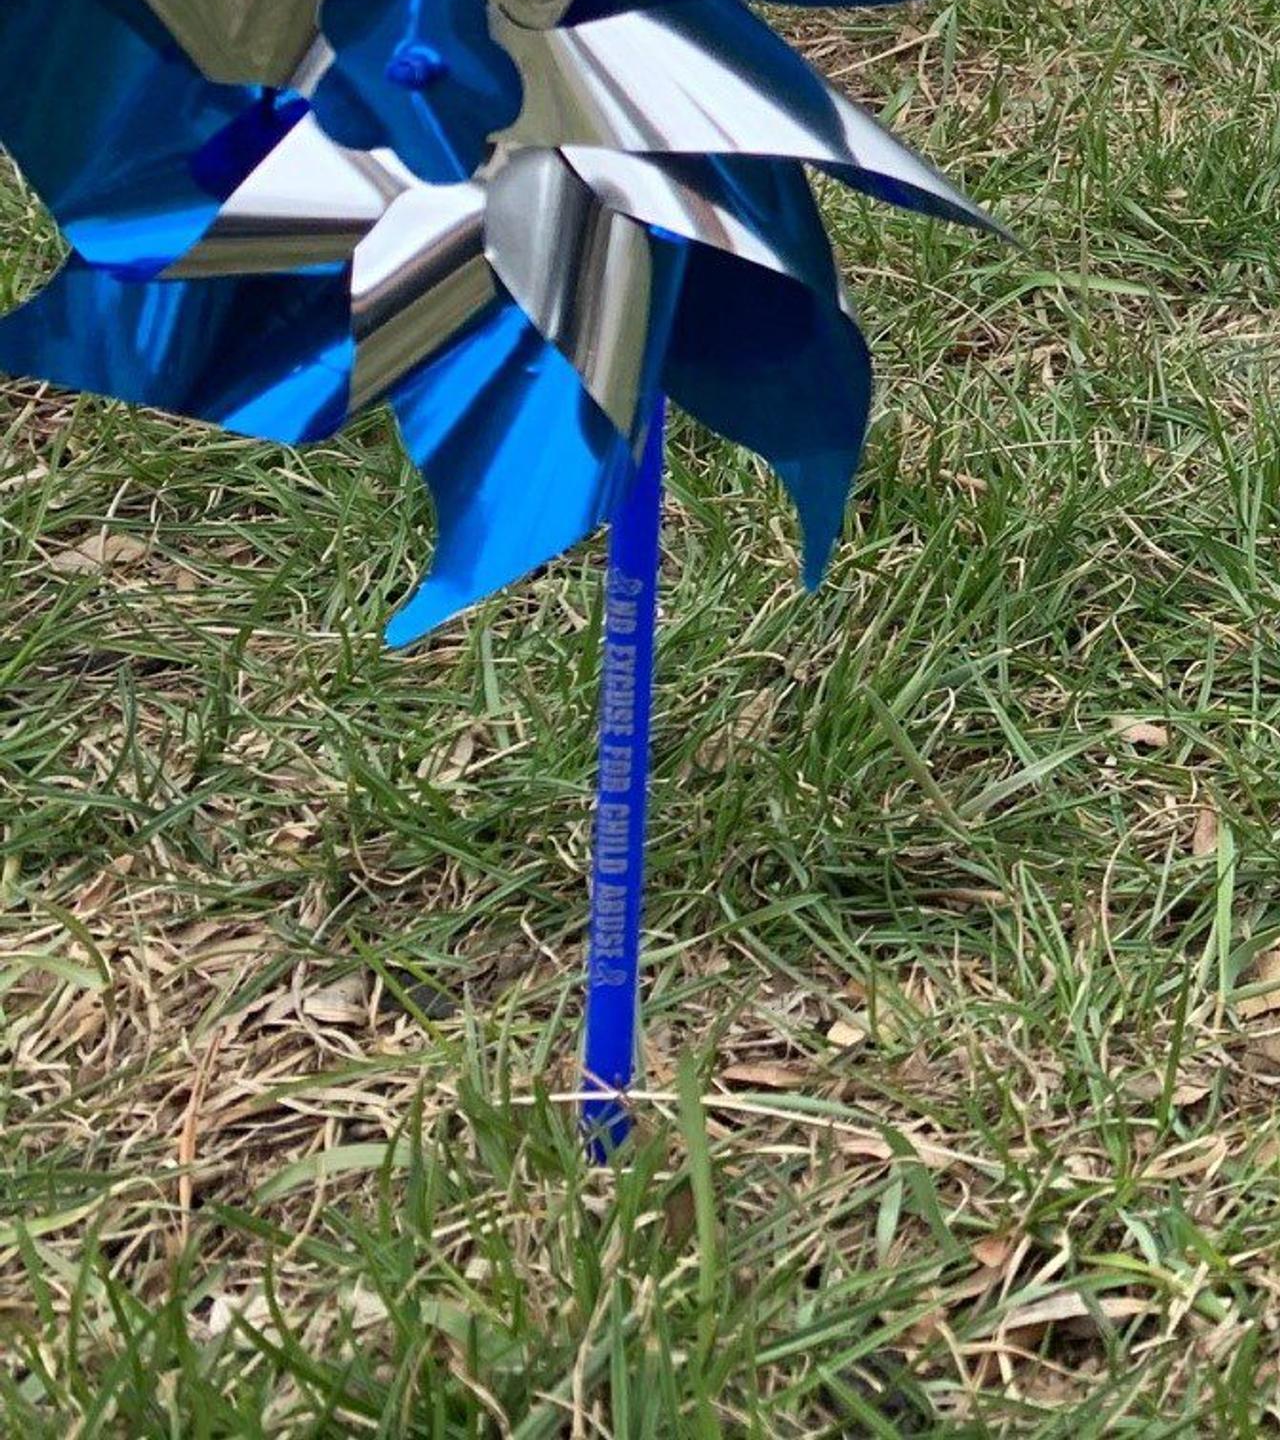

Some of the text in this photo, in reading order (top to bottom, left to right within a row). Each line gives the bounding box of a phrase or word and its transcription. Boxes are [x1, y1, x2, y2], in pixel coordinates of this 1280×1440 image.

[594, 600, 638, 959] NO EXCUSE FOR CHILD ABUSE
